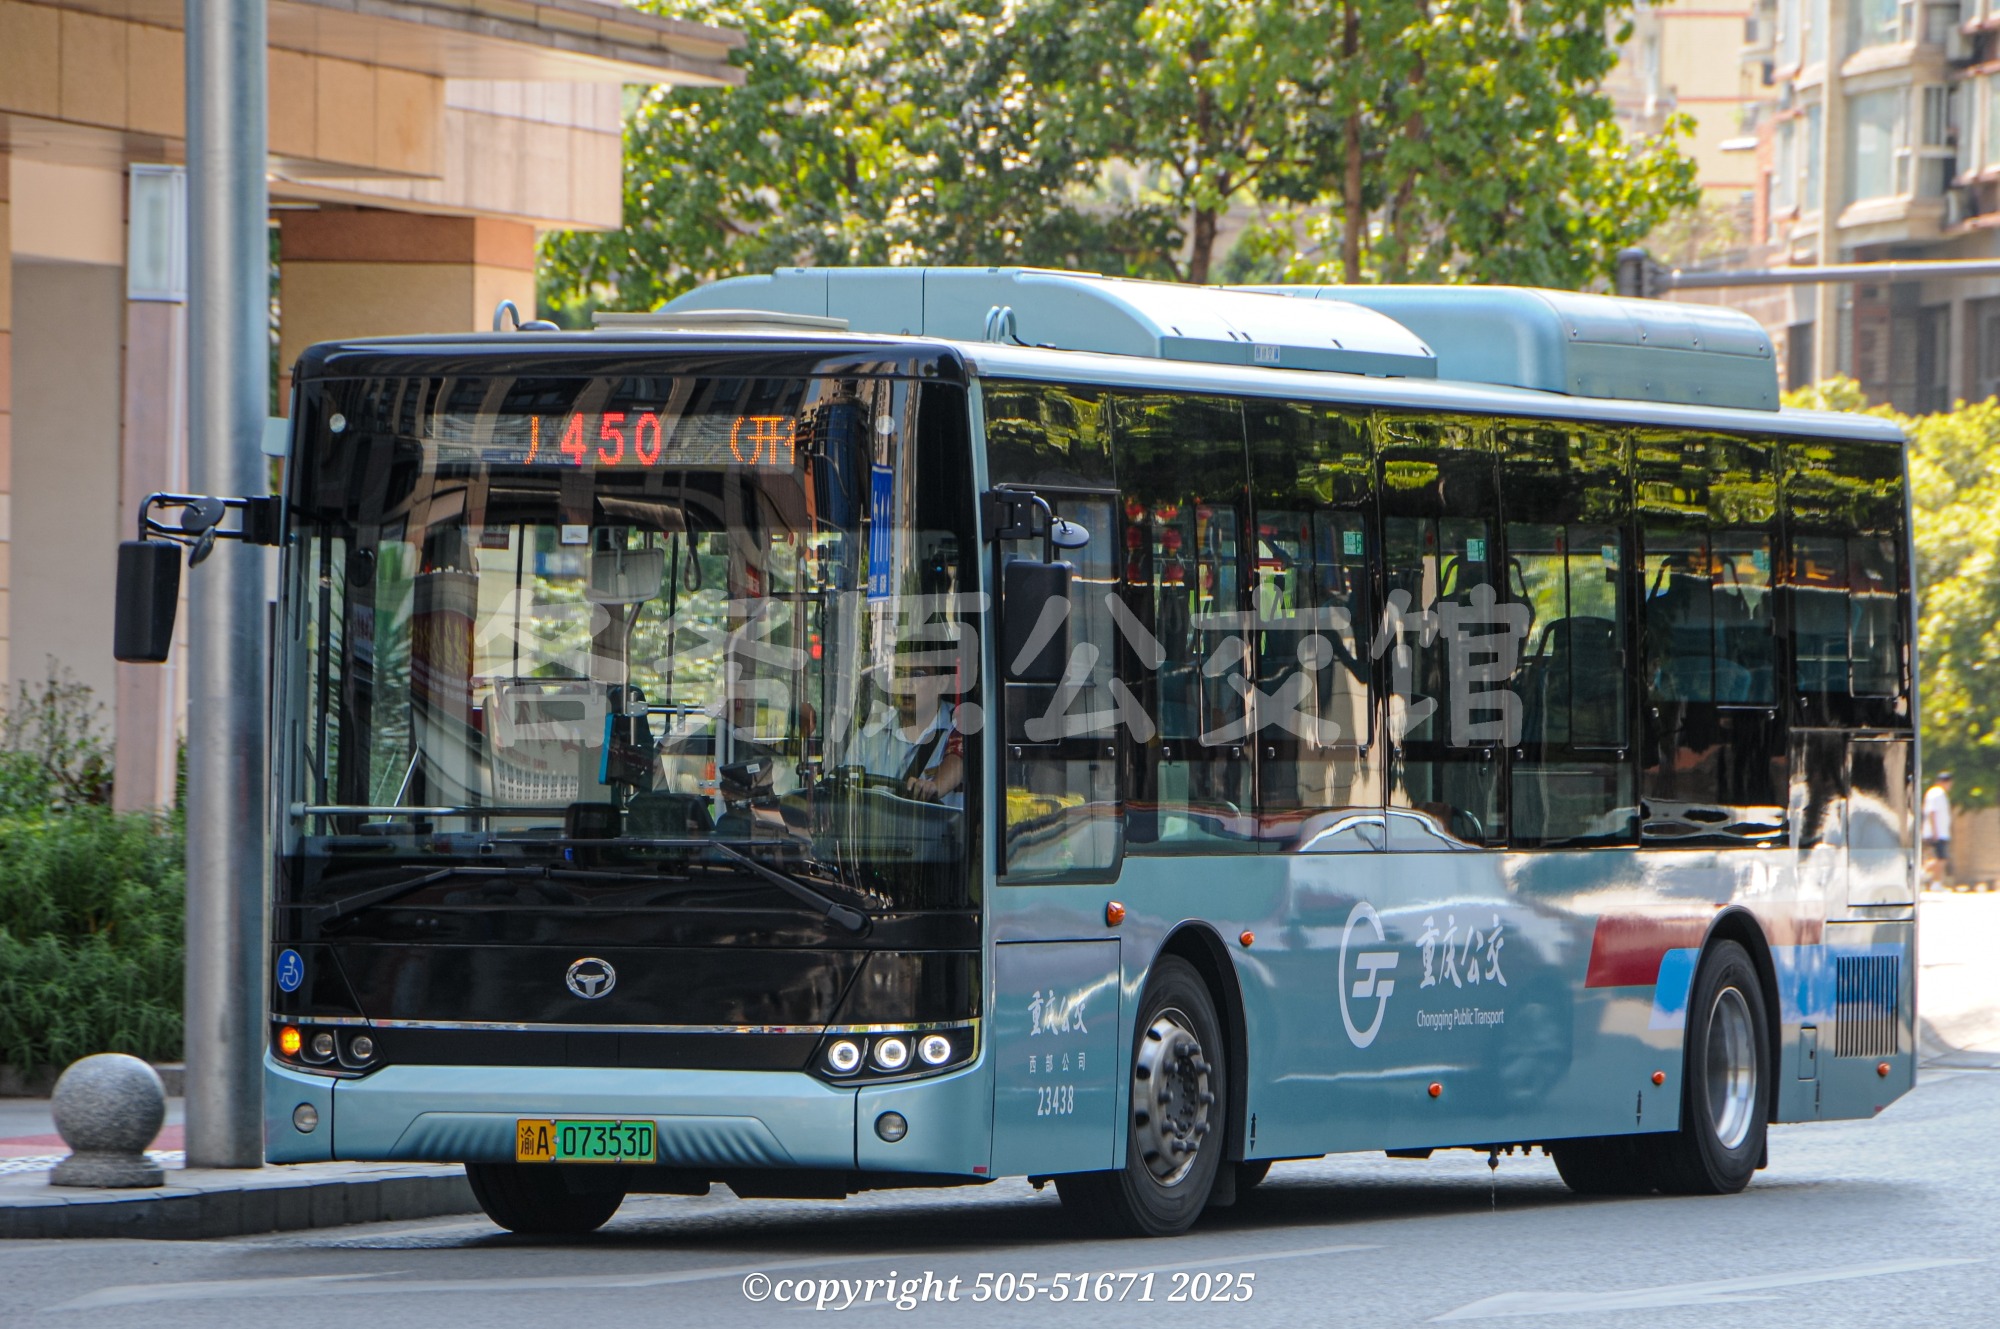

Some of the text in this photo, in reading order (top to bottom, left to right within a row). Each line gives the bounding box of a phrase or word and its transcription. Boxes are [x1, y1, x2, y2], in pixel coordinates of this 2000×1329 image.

[560, 412, 661, 465] 450
[1415, 913, 1508, 989] 重庆公交
[1416, 1007, 1505, 1031] Chongqing Public Transport
[1029, 1052, 1087, 1074] 西部公司
[1037, 1084, 1075, 1116] 23438
